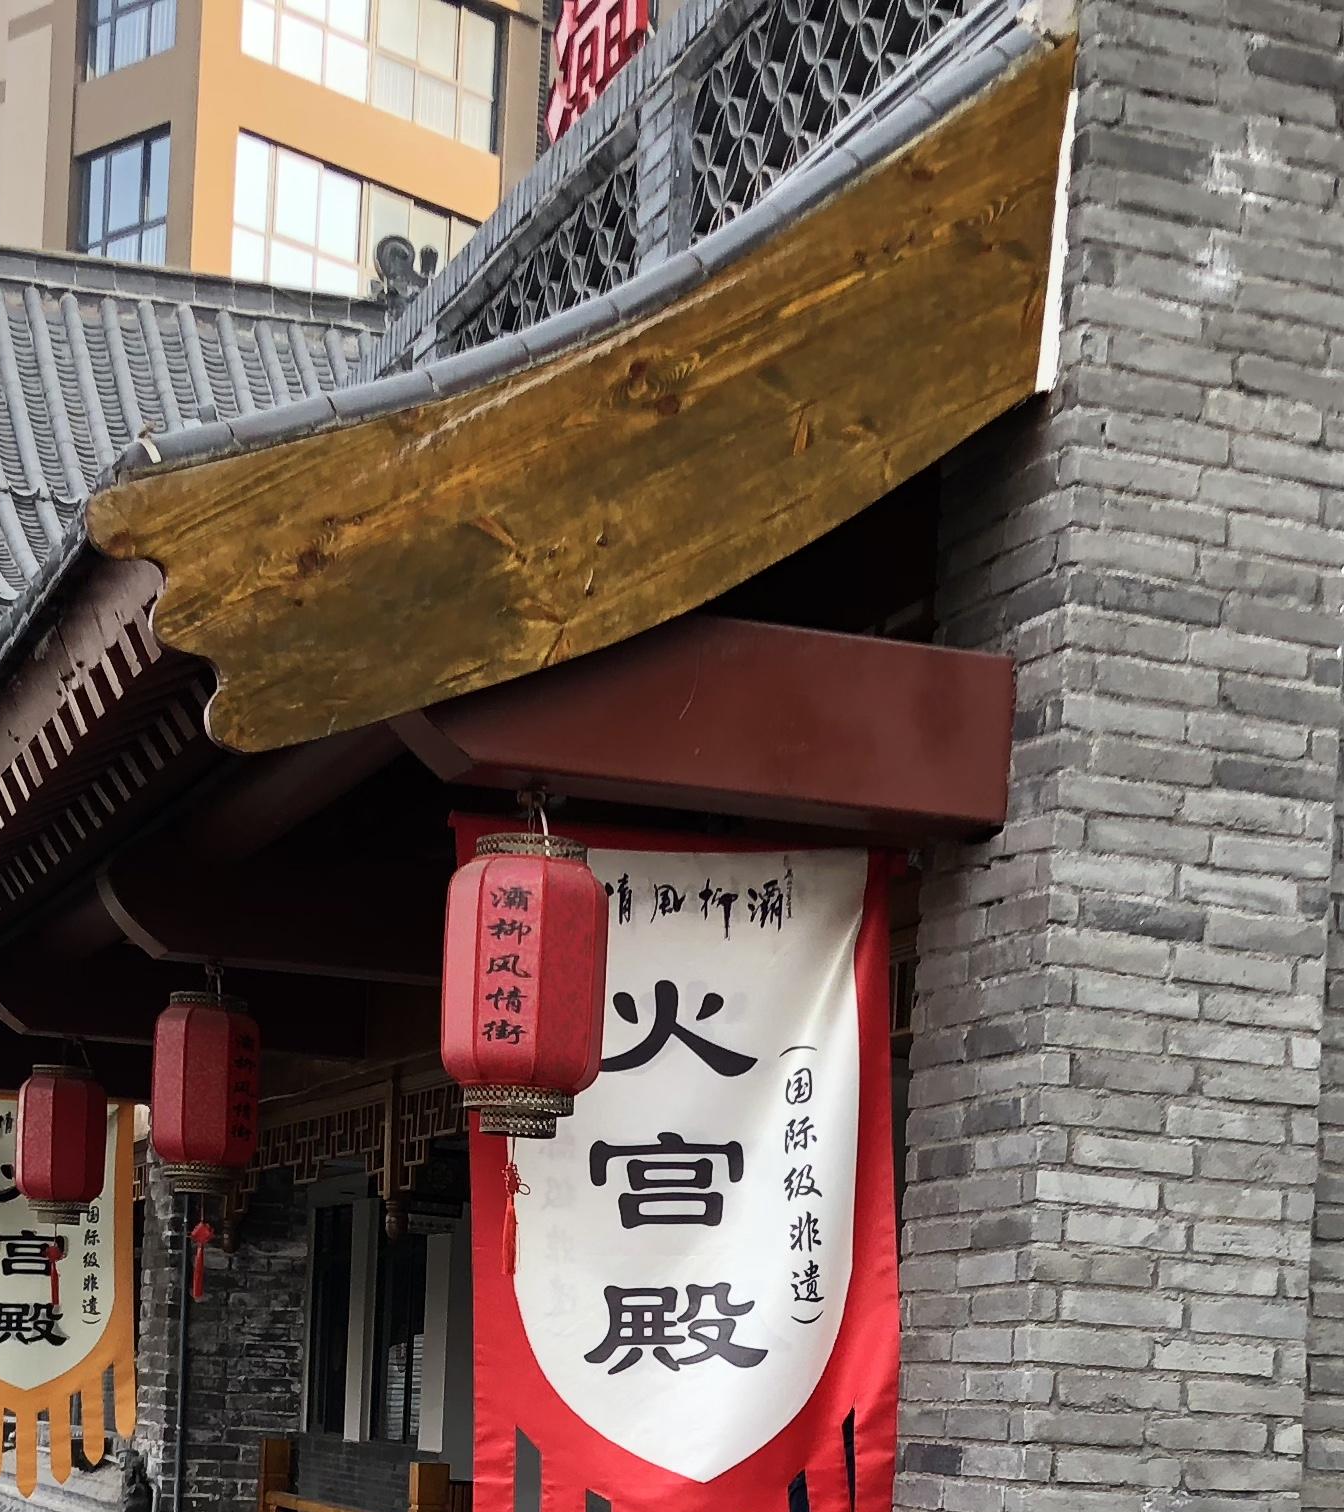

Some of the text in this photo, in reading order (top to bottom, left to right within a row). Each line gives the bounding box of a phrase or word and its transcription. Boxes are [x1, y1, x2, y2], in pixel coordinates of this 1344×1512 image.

[482, 887, 533, 1045] 灞柳风情街
[584, 979, 768, 1374] 火宫殿
[82, 1196, 101, 1325] 国际级非遗）
